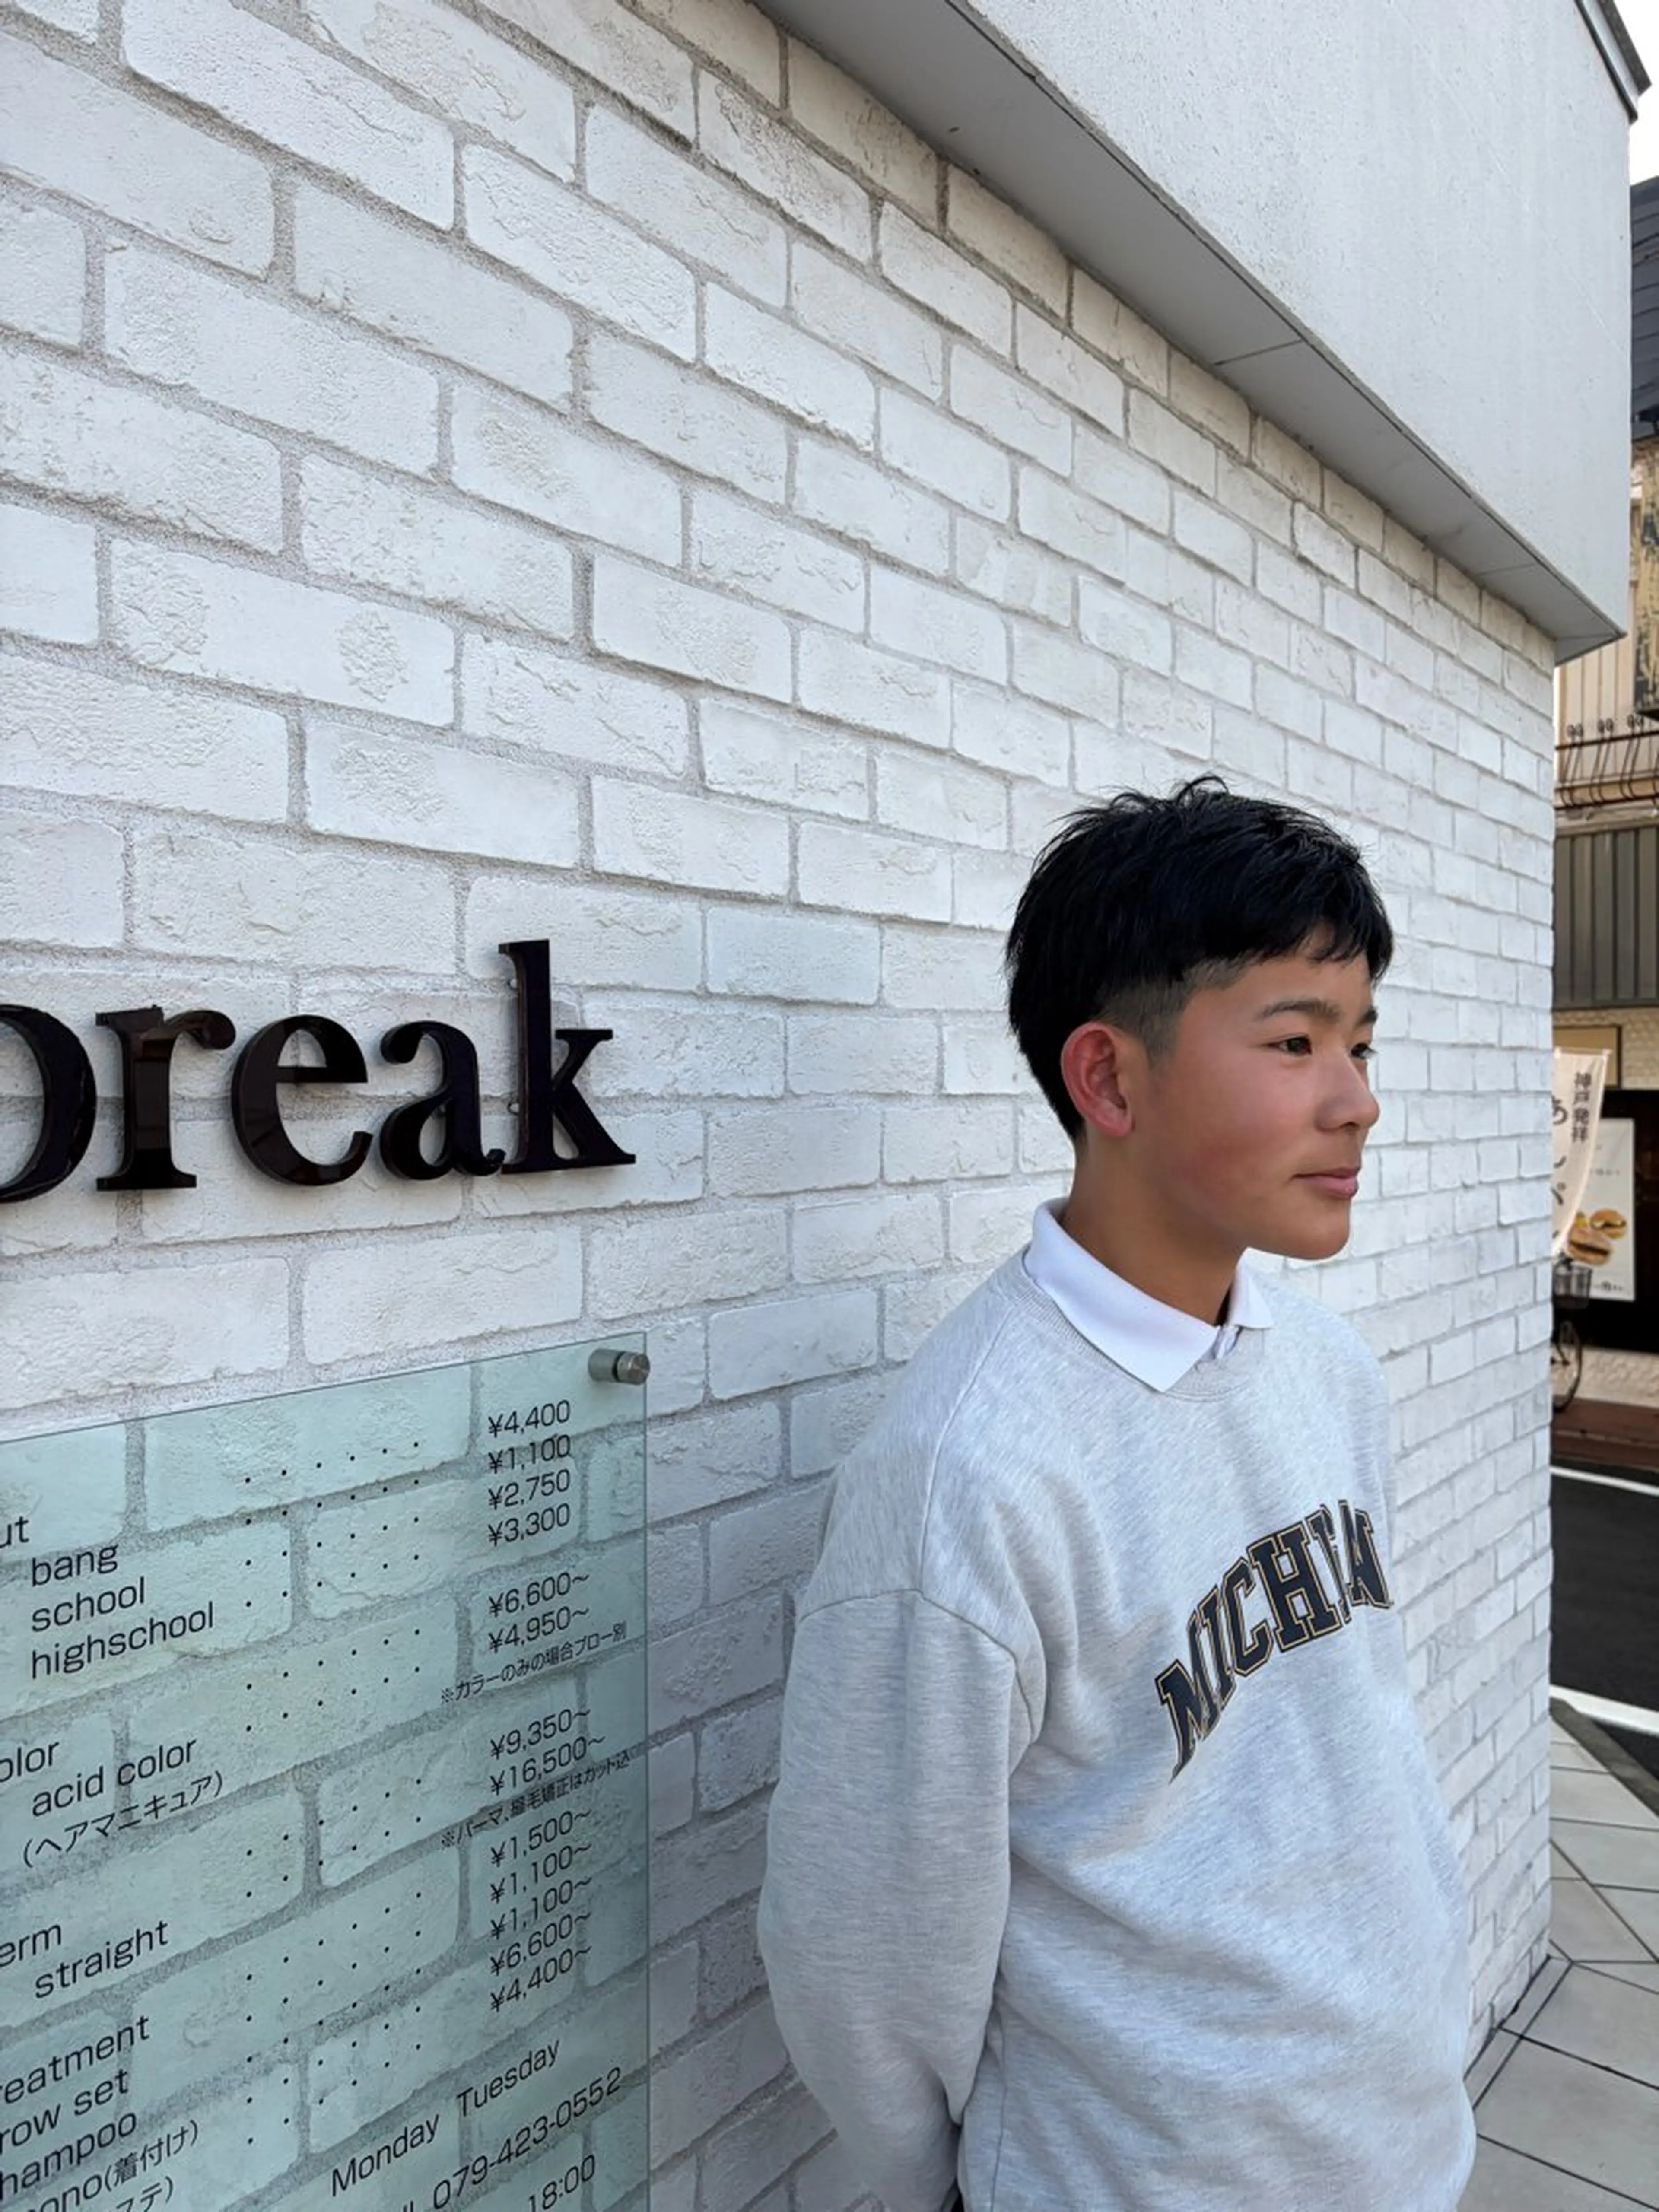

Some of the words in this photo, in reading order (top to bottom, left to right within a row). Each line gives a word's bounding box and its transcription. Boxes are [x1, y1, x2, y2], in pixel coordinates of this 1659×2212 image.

[489, 1400, 571, 1437] ¥4,400
[489, 1434, 571, 1474] ¥1,100
[489, 1469, 571, 1510] ¥2,750
[489, 1503, 571, 1546] ¥3,300
[32, 1545, 118, 1586] bang
[32, 1576, 145, 1632] school
[32, 1601, 213, 1679] highschool
[1154, 1498, 1395, 1784] MICHIN
[32, 1766, 104, 1816] acid
[117, 1739, 197, 1786] color
[35, 1921, 168, 1999] straight
[0, 2015, 150, 2104] eatment
[74, 2069, 129, 2117] set
[332, 2115, 440, 2196] Monday
[456, 2040, 559, 2117] Tuesday
[433, 2067, 622, 2209] 079-423-0552
